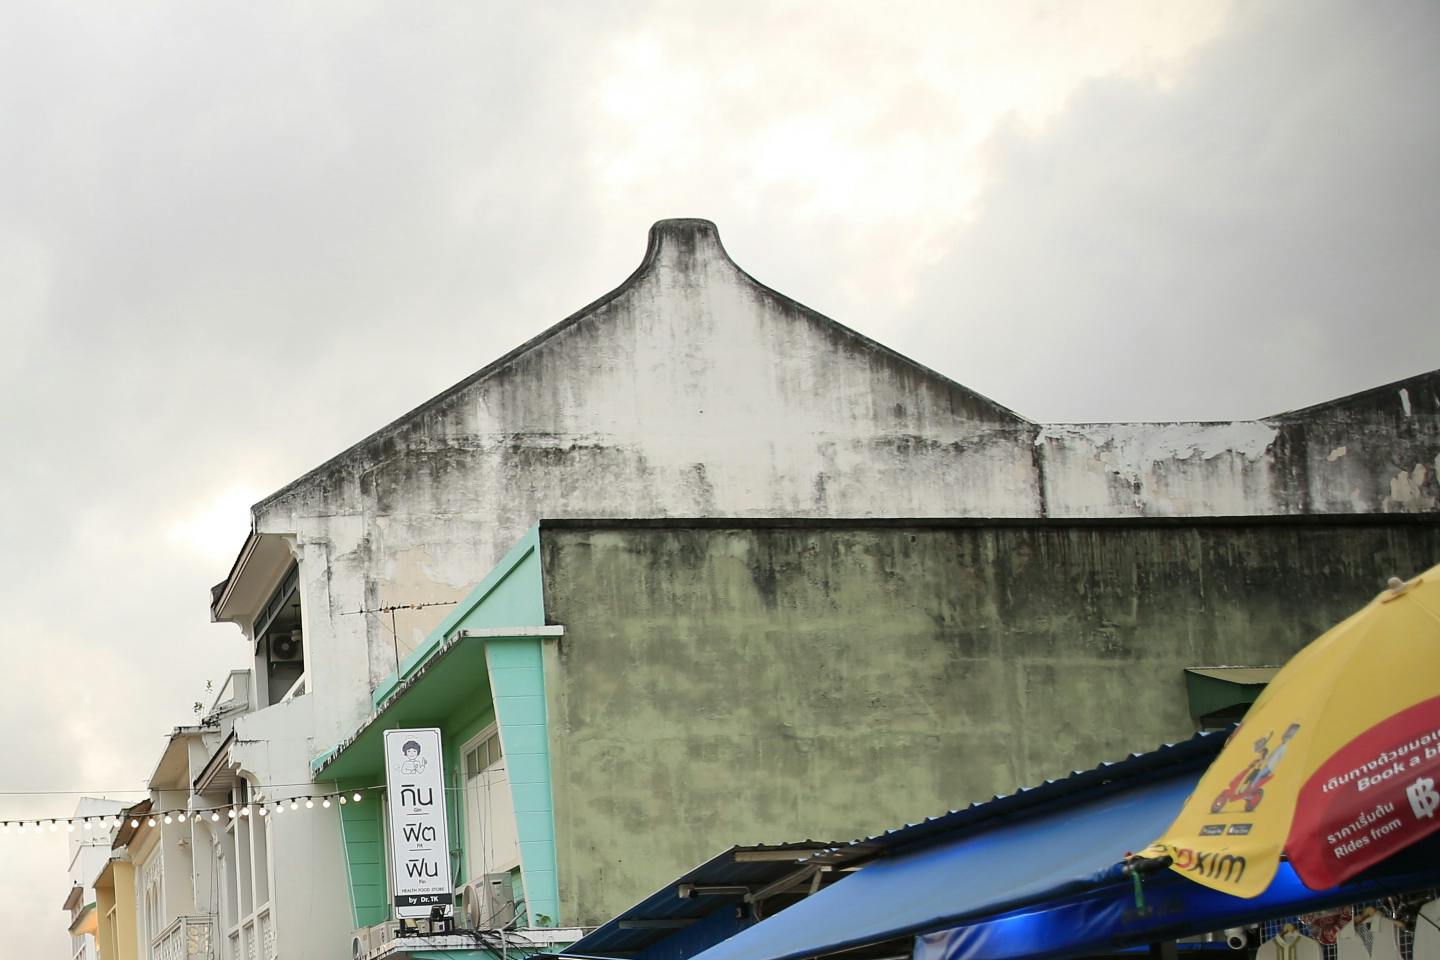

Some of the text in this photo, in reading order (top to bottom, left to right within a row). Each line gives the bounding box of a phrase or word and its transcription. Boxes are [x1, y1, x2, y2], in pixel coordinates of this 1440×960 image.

[1322, 728, 1440, 792] เดินทางด้วยมอเ
[1357, 762, 1404, 791] Book
[1409, 756, 1420, 767] a
[401, 784, 433, 807] กิน
[403, 822, 436, 842] ฟิต
[1334, 818, 1402, 859] Rides from
[406, 858, 438, 878] ฟิน
[408, 896, 417, 904] by
